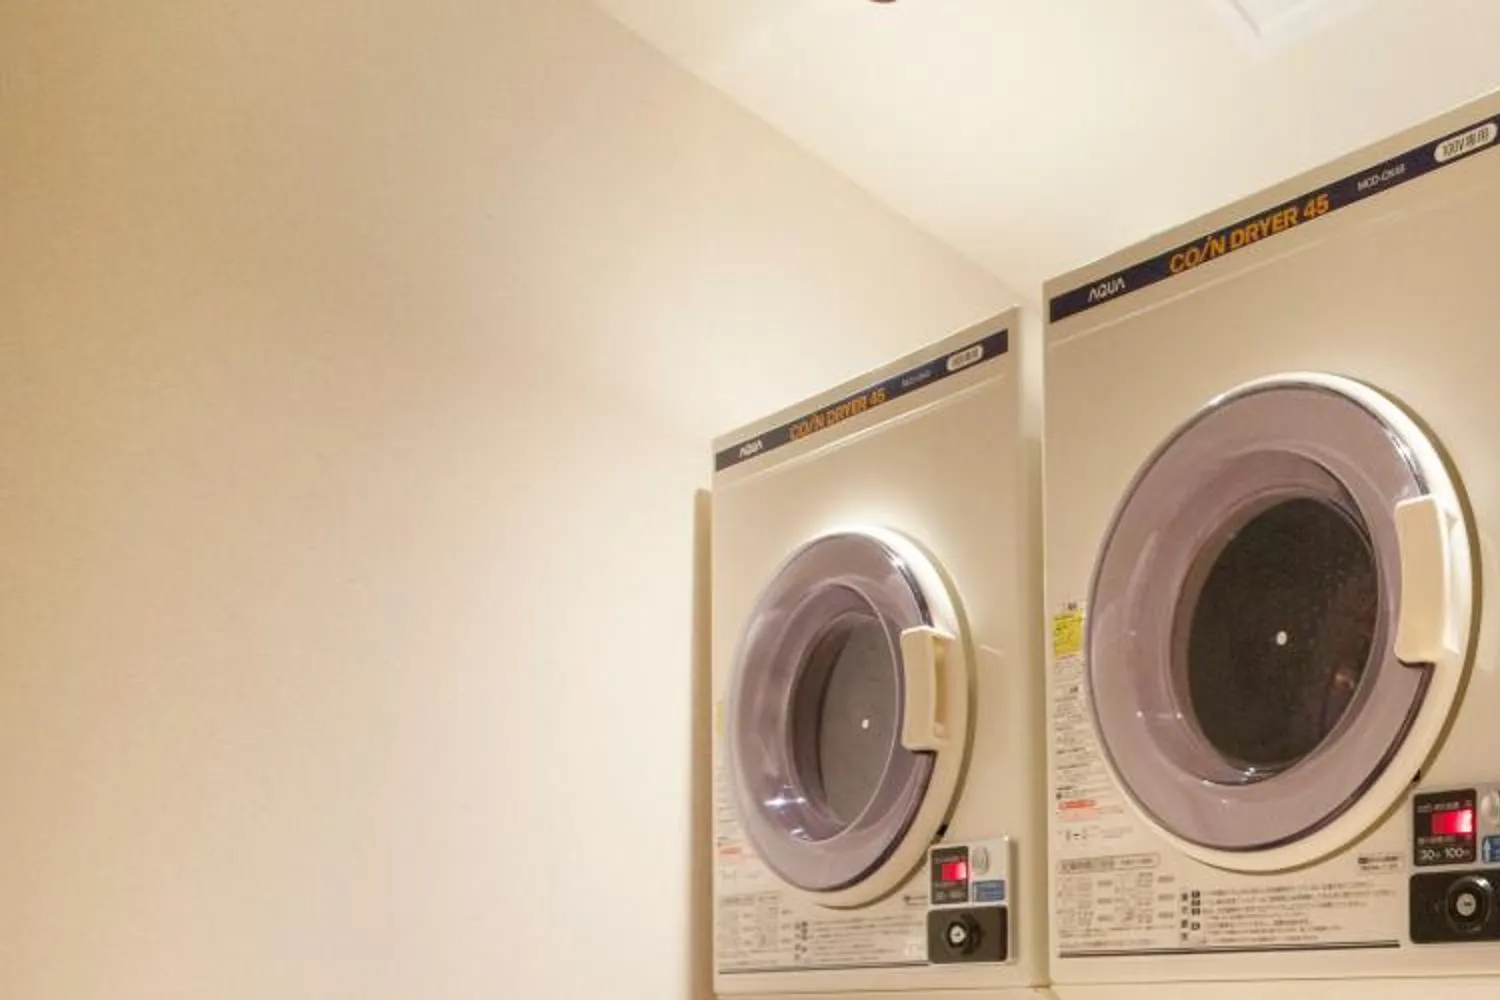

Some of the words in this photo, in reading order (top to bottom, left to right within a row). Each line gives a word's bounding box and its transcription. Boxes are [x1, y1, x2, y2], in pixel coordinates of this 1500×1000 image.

[1088, 276, 1126, 303] AQUA
[1230, 205, 1299, 249] DRYER
[1303, 193, 1330, 218] 45
